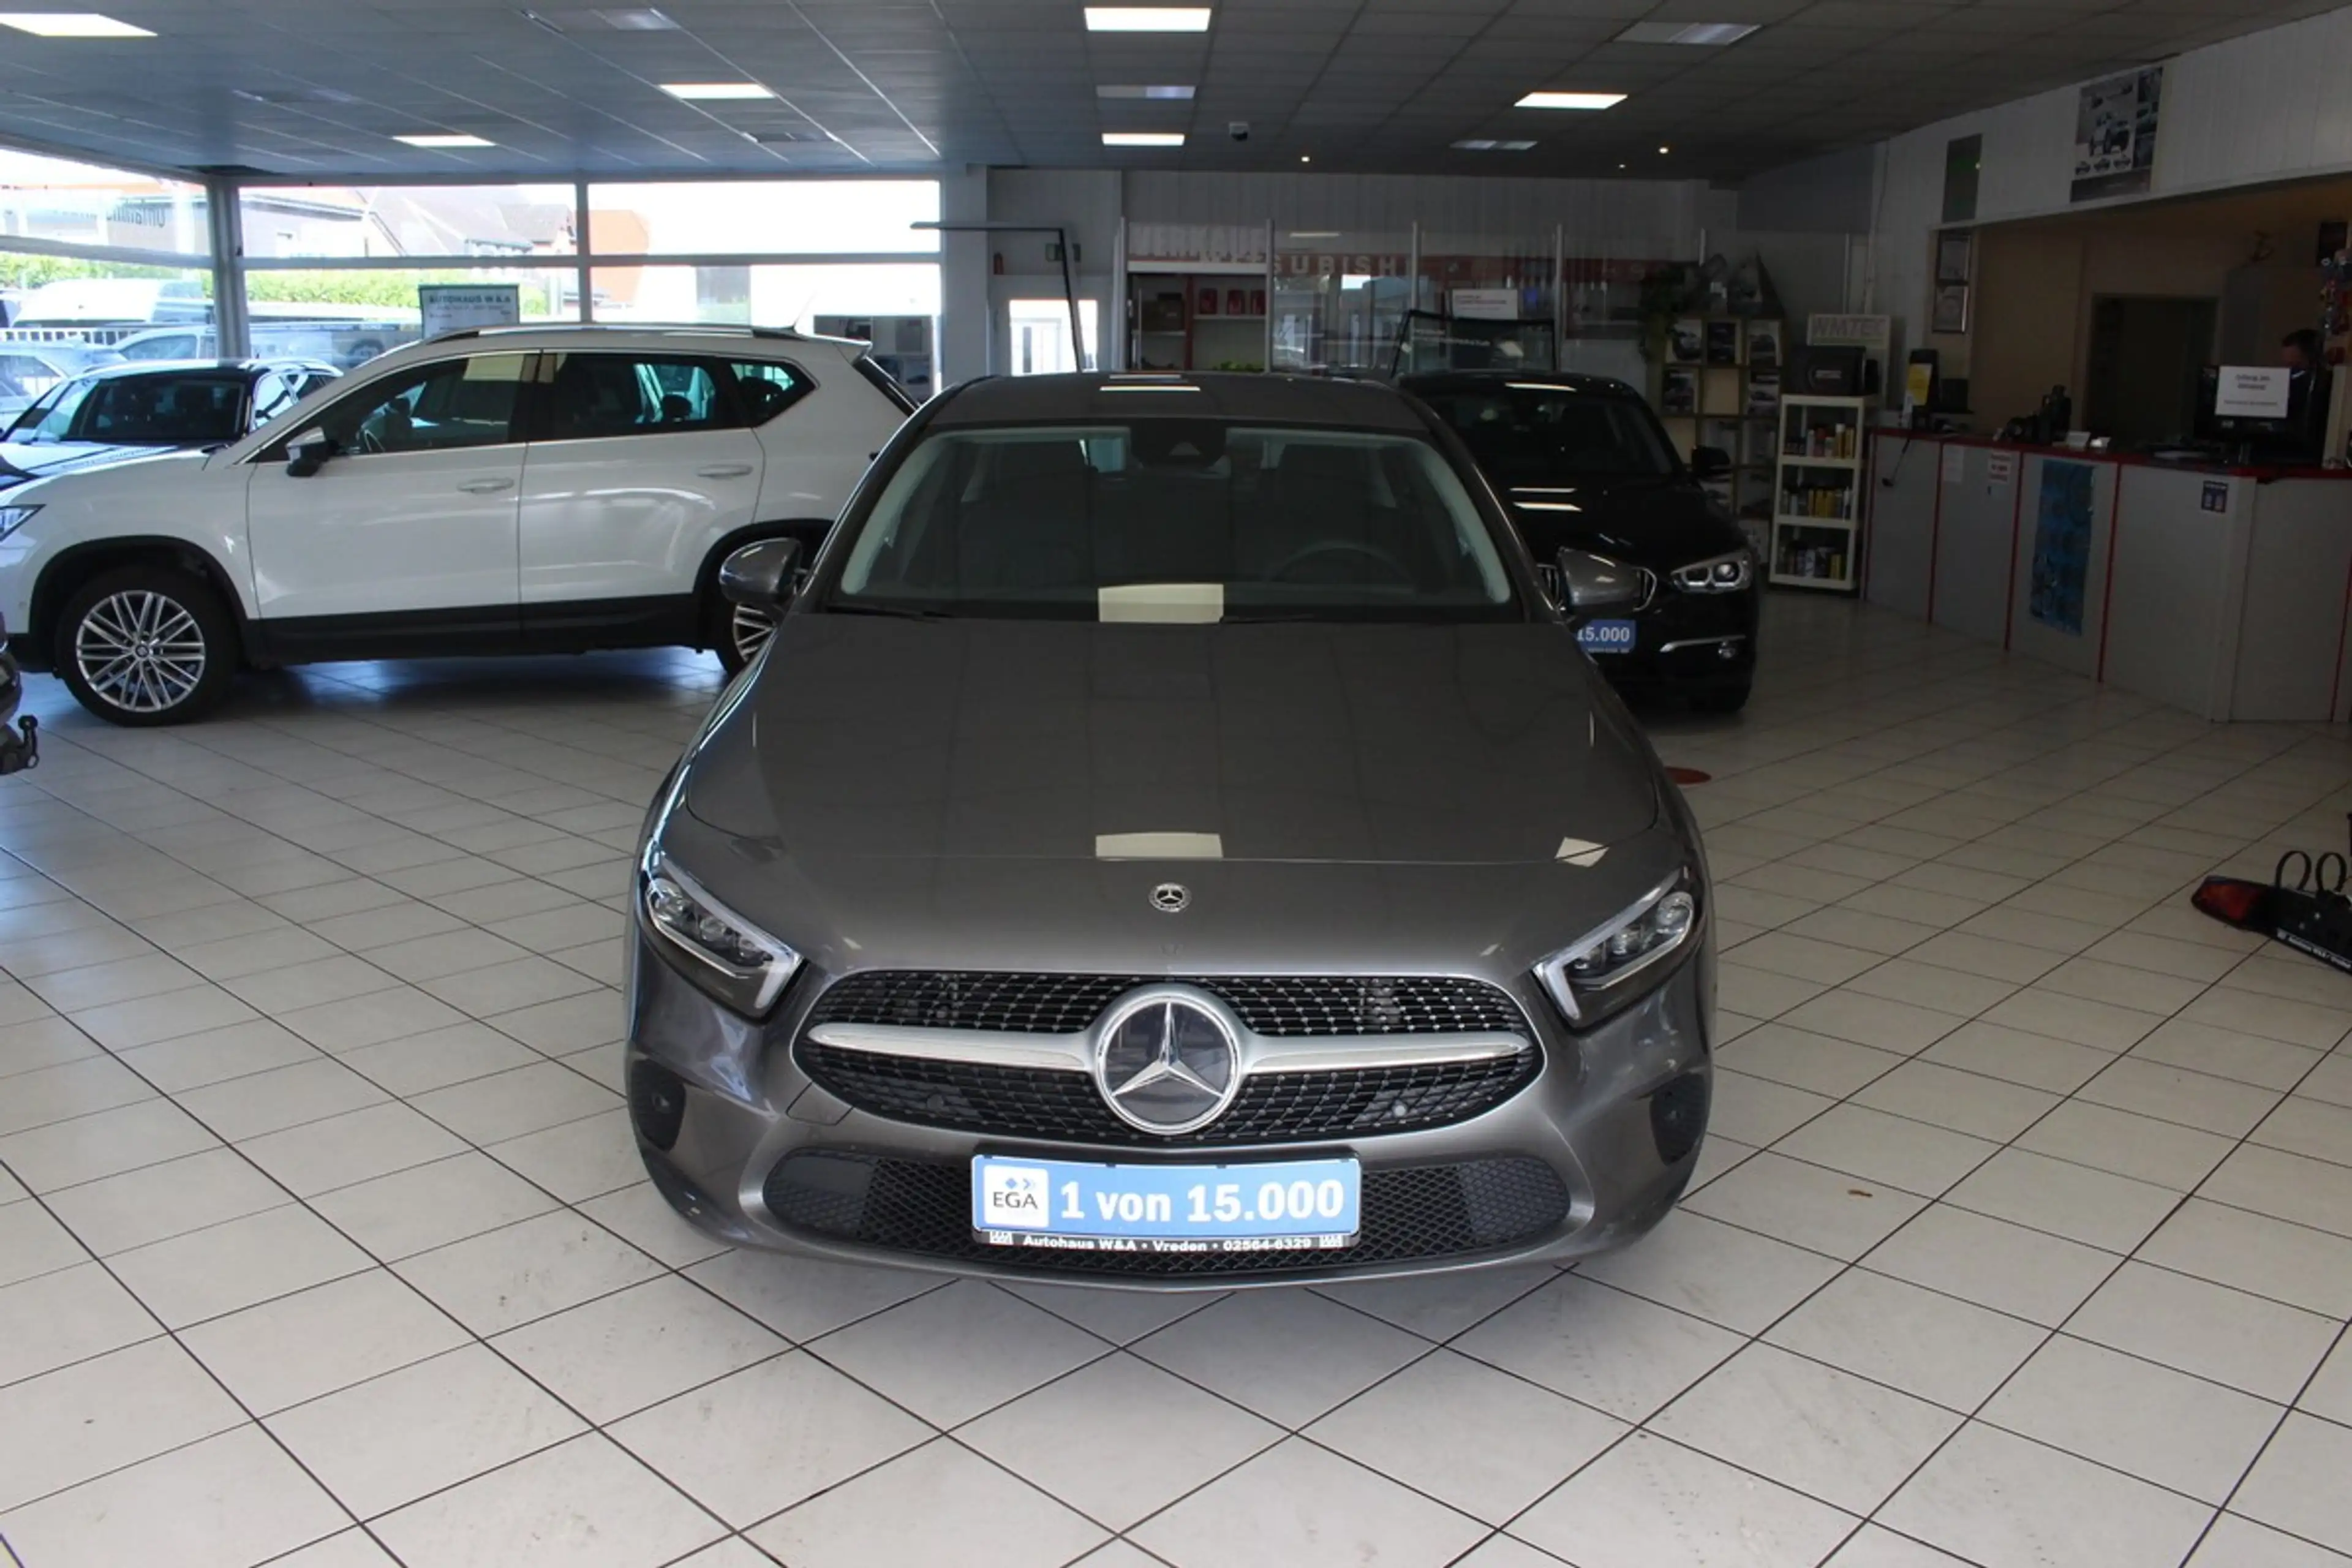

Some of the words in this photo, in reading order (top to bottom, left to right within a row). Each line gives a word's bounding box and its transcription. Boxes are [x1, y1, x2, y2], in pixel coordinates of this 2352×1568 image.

[1577, 627, 1630, 642] 15.000
[993, 1191, 1038, 1209] EGA
[1061, 1181, 1085, 1219] 1
[1096, 1191, 1170, 1221] von
[1187, 1180, 1344, 1222] 15.000
[1023, 1235, 1095, 1250] Autohaus
[1098, 1238, 1137, 1251] W&A
[1153, 1240, 1207, 1252] Vreden
